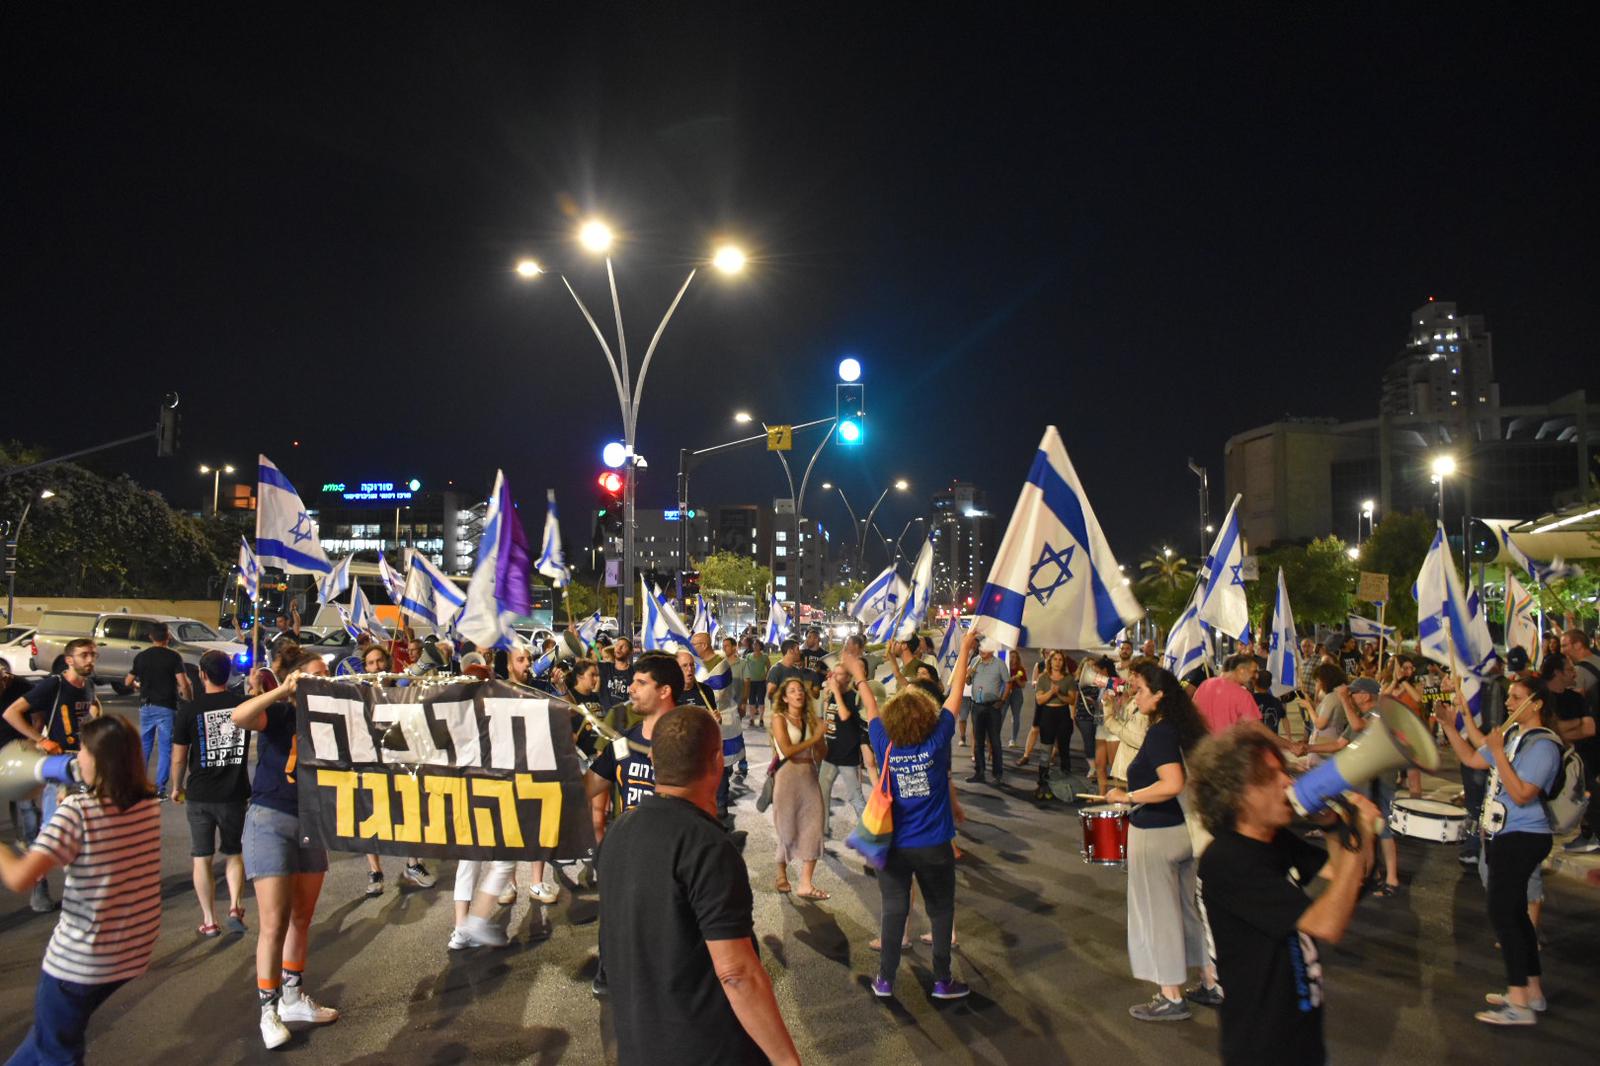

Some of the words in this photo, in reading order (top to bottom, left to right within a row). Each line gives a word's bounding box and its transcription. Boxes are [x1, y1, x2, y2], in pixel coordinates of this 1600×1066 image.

[775, 432, 784, 444] 7
[361, 483, 393, 493] סורוקה
[307, 694, 558, 770] חובה
[207, 746, 244, 762] סורקים
[917, 751, 930, 762] אין
[317, 769, 563, 848] להתנגד
